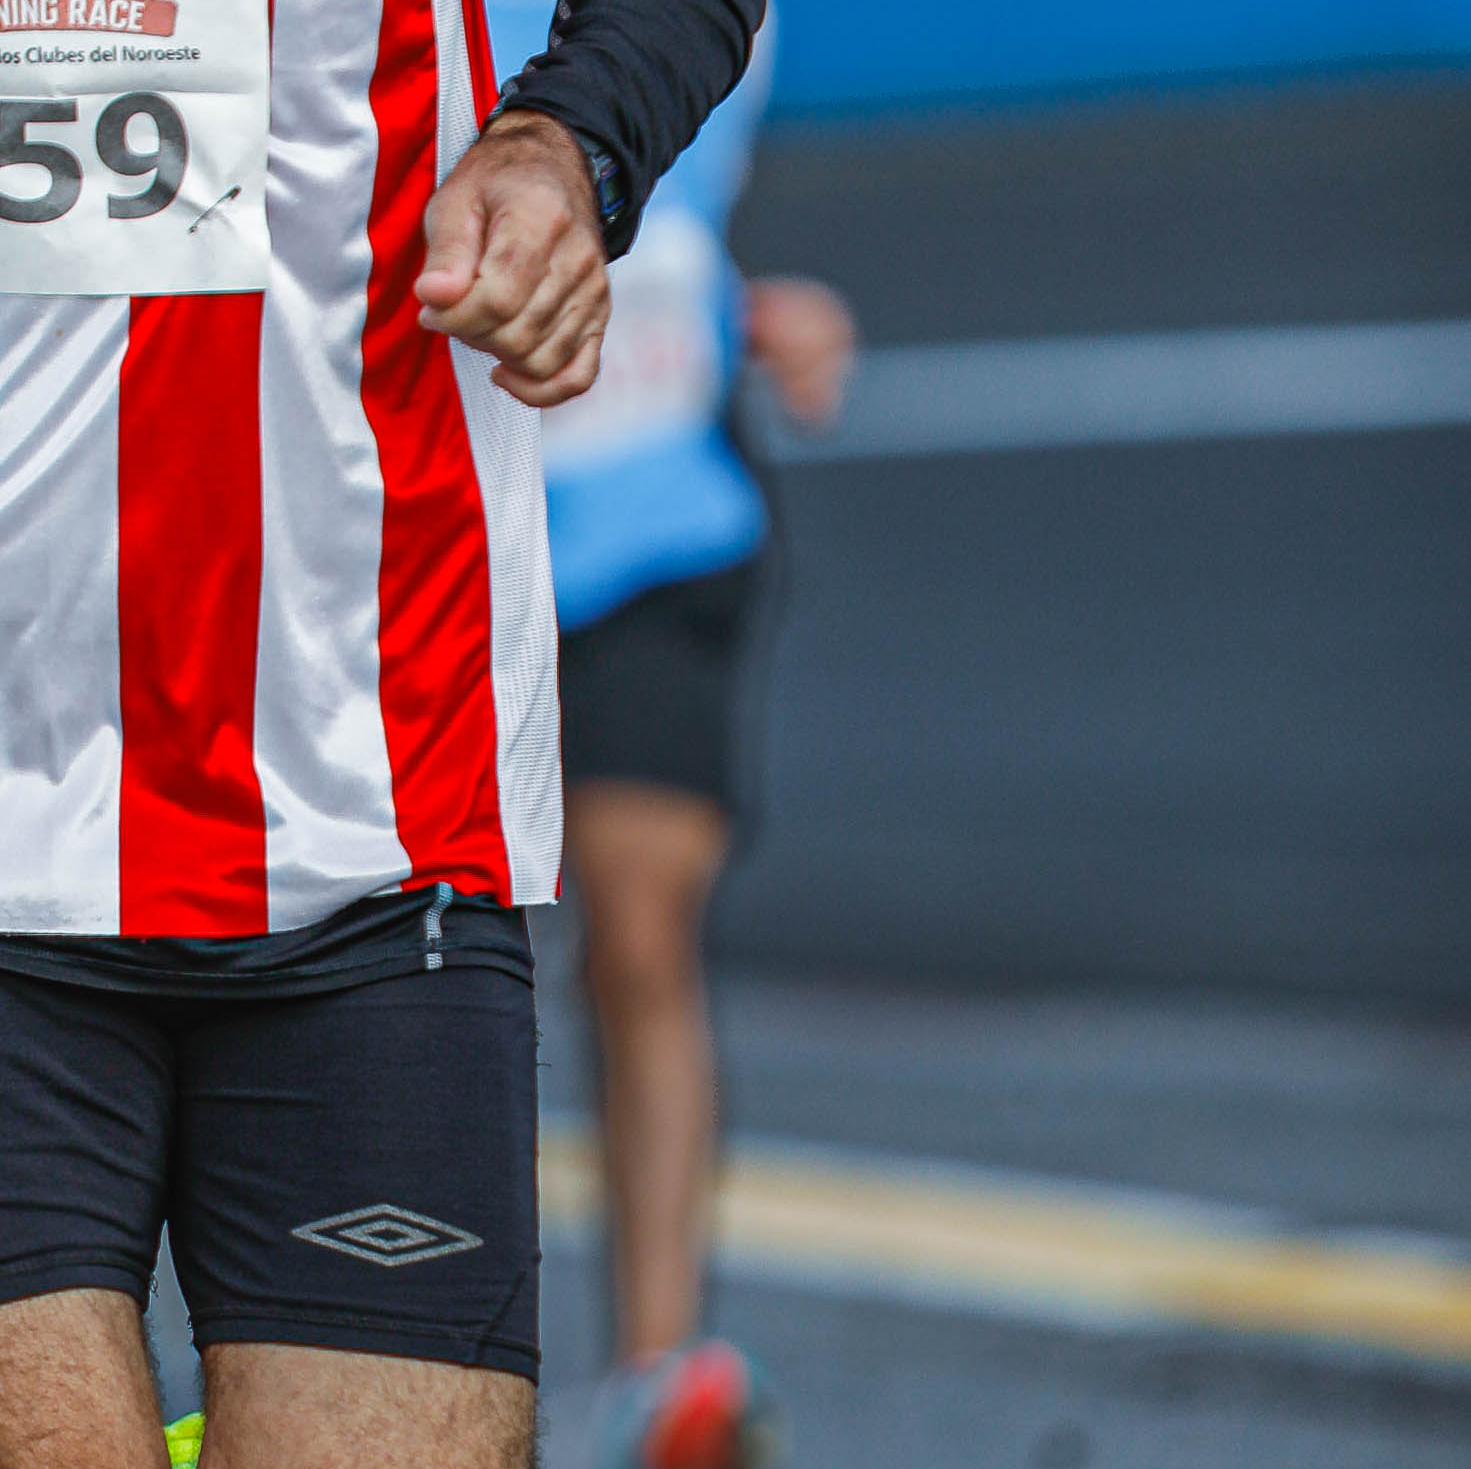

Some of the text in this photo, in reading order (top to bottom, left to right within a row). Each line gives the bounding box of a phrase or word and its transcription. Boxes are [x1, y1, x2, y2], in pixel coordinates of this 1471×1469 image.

[26, 46, 85, 63] Clubes
[90, 46, 117, 62] del
[122, 46, 201, 62] Noroeste
